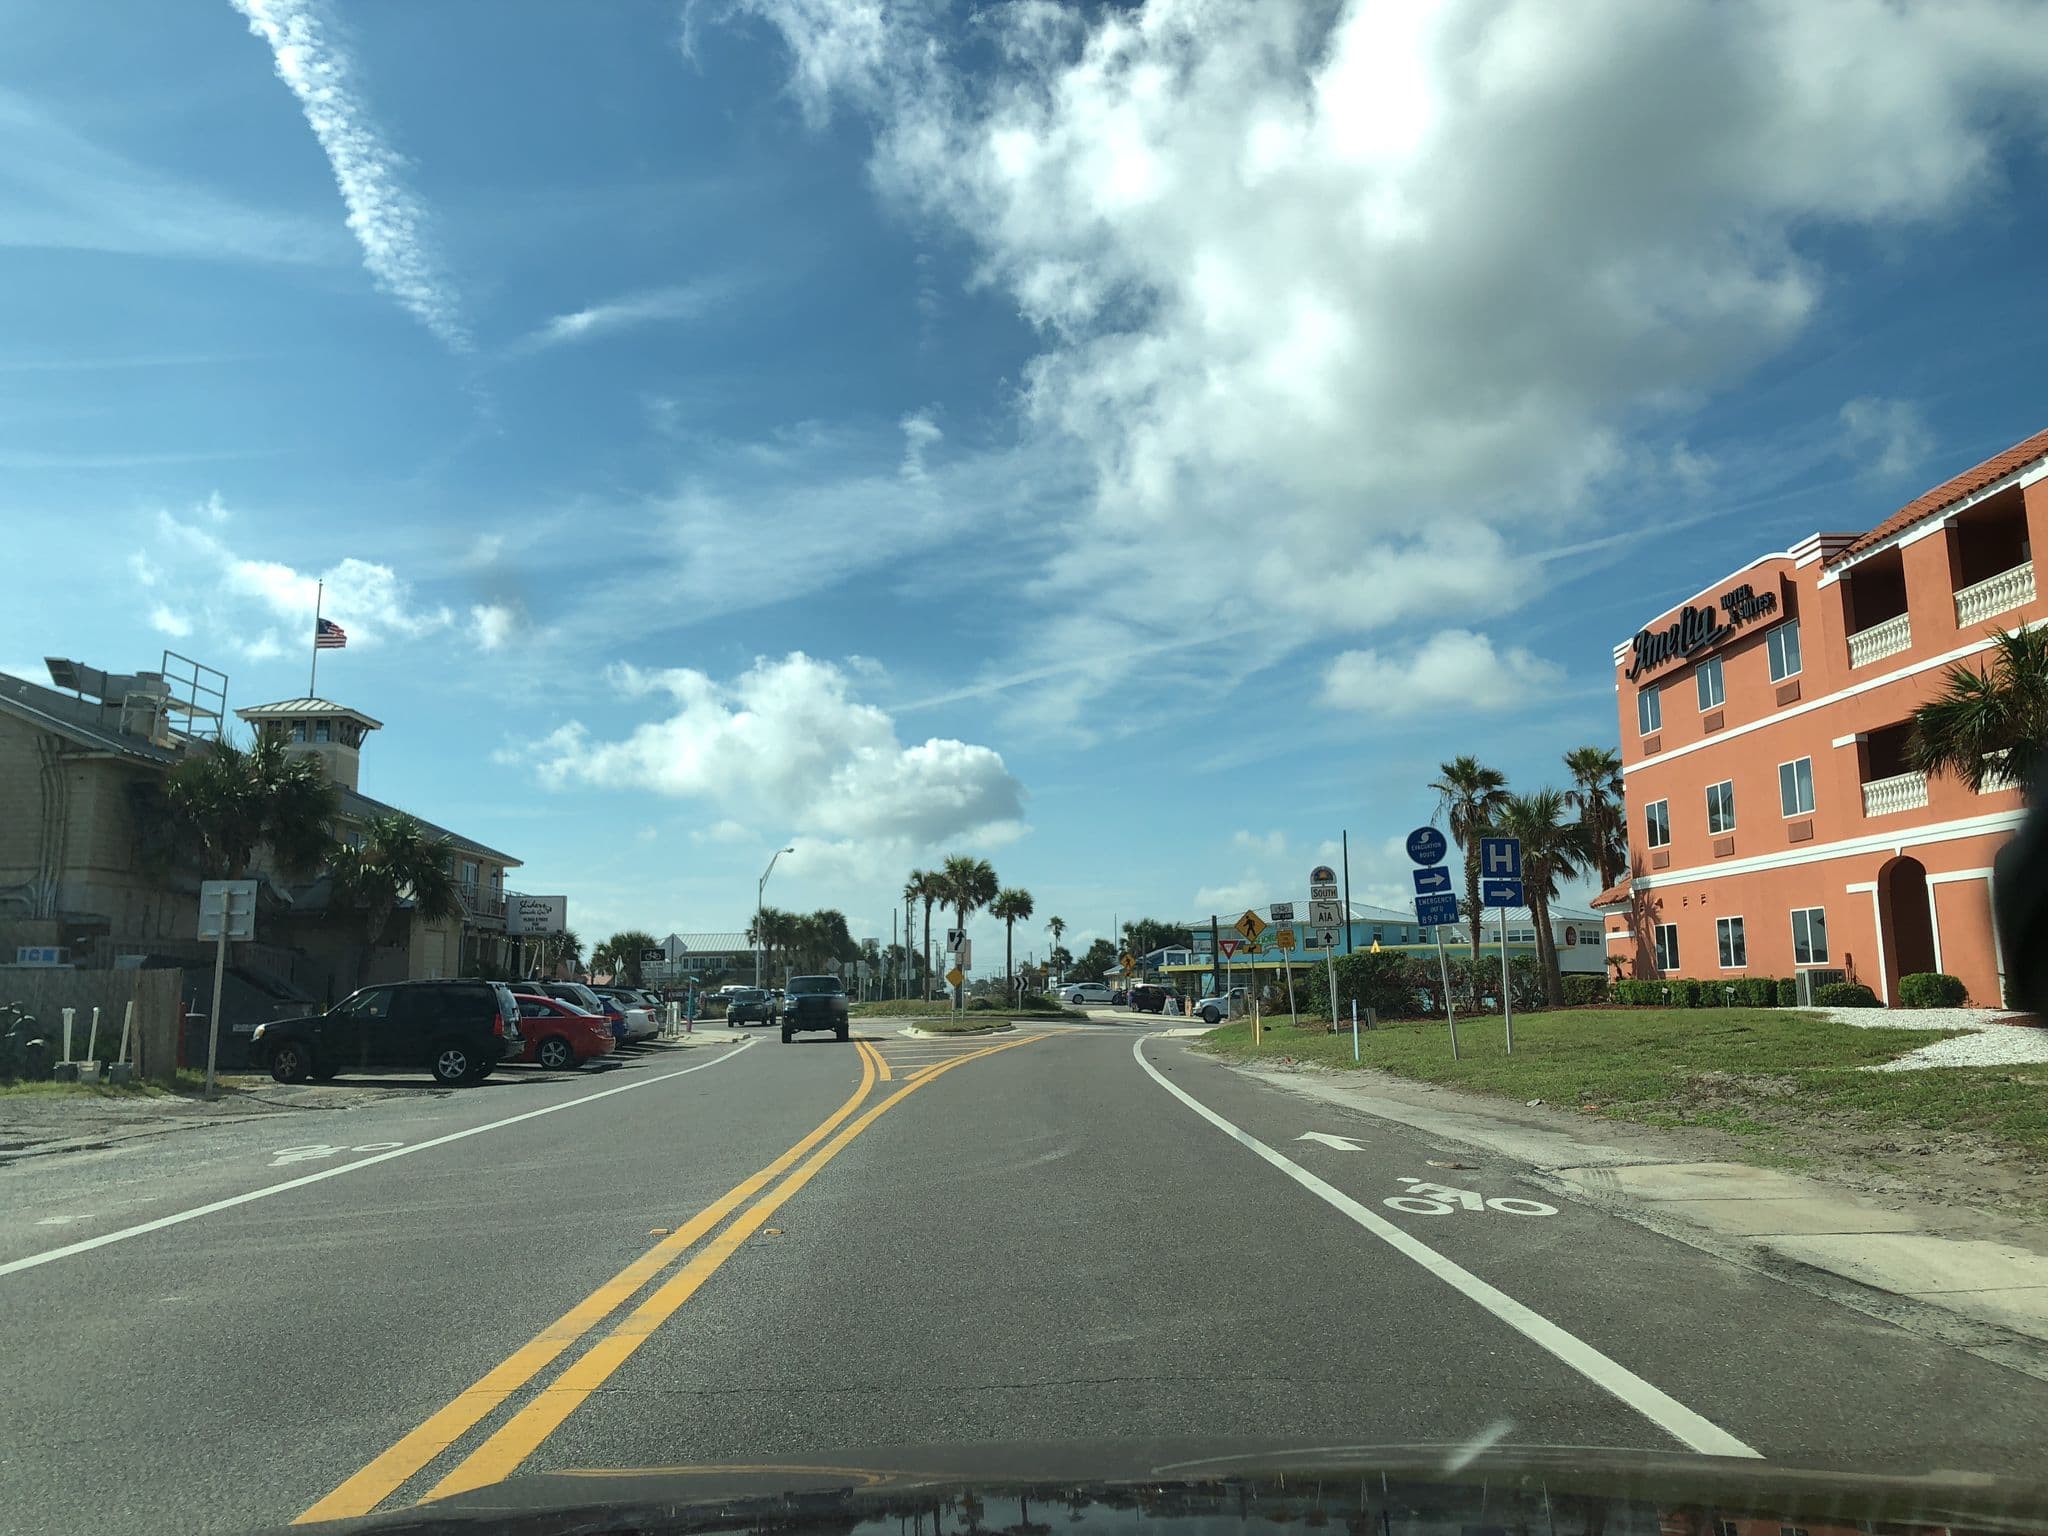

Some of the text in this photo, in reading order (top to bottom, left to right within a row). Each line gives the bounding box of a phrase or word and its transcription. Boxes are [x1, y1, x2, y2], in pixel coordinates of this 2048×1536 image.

[1720, 584, 1752, 610] HOTEL
[1738, 592, 1774, 620] SUITES
[1626, 606, 1729, 679] Amelia
[1490, 844, 1512, 872] H
[1313, 888, 1336, 898] SOUTH
[1418, 896, 1452, 906] EMERGENCY
[1318, 912, 1333, 922] A1A
[1444, 912, 1456, 921] FM
